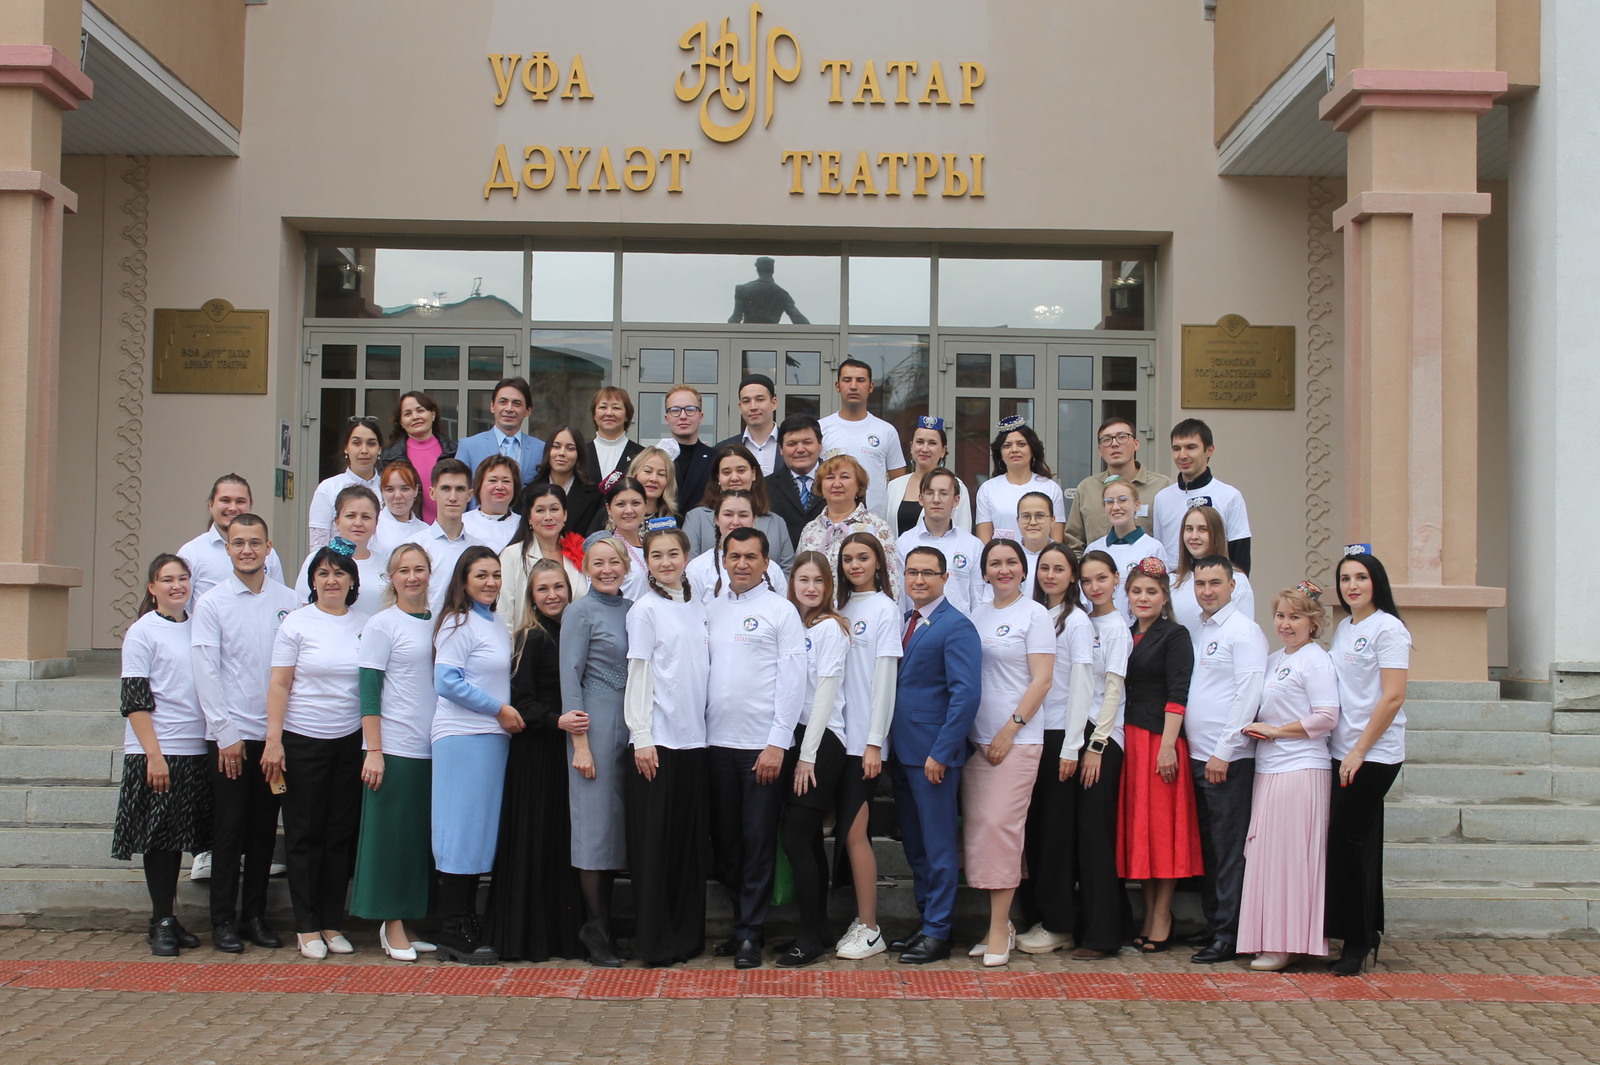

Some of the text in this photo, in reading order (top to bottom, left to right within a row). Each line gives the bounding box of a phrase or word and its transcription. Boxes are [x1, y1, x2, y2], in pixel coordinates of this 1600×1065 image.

[487, 51, 595, 107] УФА
[819, 59, 987, 106] ТАТАР
[483, 143, 987, 200] ДӘҮЛӘТ ТЕАТРЫ
